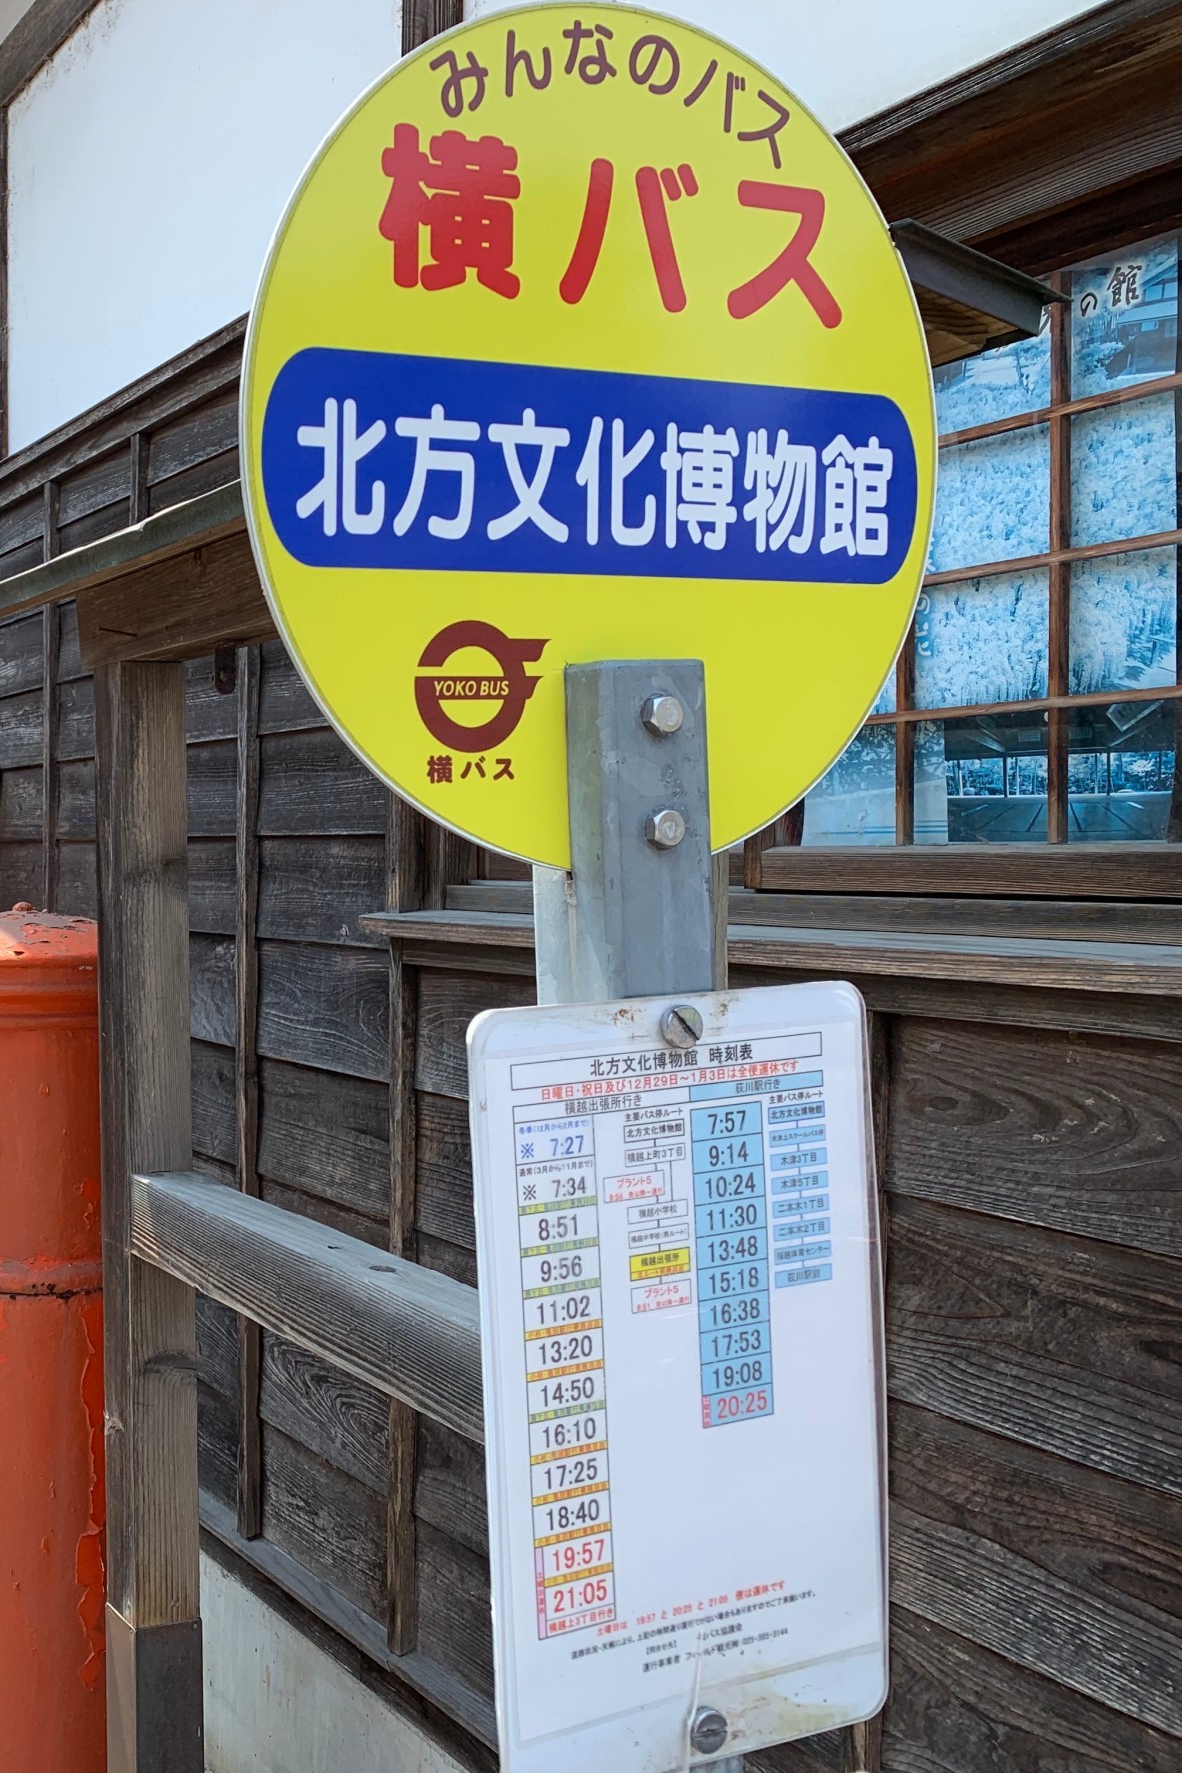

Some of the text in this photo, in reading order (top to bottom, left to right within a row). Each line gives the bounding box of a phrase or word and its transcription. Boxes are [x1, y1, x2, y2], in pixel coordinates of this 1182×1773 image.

[429, 18, 792, 169] みんなのバス
[380, 122, 843, 330] 横バス
[296, 397, 894, 557] 北方文化博物館
[434, 681, 509, 696] YOKO BUS
[427, 755, 515, 784] 横バス
[590, 1043, 753, 1077] 北方文化博物館 時刻表
[735, 1078, 781, 1094] 荻川駅行き
[769, 1090, 824, 1105] 主要バス停ルート
[565, 1094, 642, 1115] 横越出張所行き
[624, 1107, 684, 1122] 主要バス停ルート
[771, 1104, 824, 1120] 北方文化博物館
[626, 1122, 683, 1138] 北方文化博物館
[707, 1110, 747, 1135] 7:57
[550, 1135, 585, 1157] 7:27
[627, 1146, 683, 1163] 横越上町3丁目
[709, 1141, 749, 1167] 9:14
[780, 1151, 817, 1165] 木津3丁目
[551, 1176, 587, 1198] 7:34
[705, 1172, 756, 1199] 10:24
[780, 1175, 819, 1189] 木津5丁目
[639, 1204, 678, 1219] 横越小学校
[706, 1203, 757, 1231] 11:30
[777, 1197, 825, 1214] 二本木1丁目
[538, 1214, 578, 1241] 8:51
[778, 1221, 826, 1237] 二本木2丁目
[641, 1252, 680, 1267] 横越出張所
[708, 1235, 758, 1263] 13:48
[540, 1255, 582, 1283] 9:56
[709, 1266, 759, 1294] 15:18
[537, 1295, 591, 1325] 11:02
[710, 1298, 760, 1326] 16:38
[538, 1335, 593, 1365] 13:20
[711, 1329, 762, 1358] 17:53
[712, 1360, 763, 1389] 19:08
[540, 1377, 595, 1407] 14:50
[717, 1389, 767, 1419] 20:25
[542, 1417, 596, 1448] 16:10
[544, 1458, 598, 1489] 17:25
[546, 1498, 600, 1531] 18:40
[552, 1538, 605, 1571] 19:57
[553, 1578, 607, 1613] 21:05
